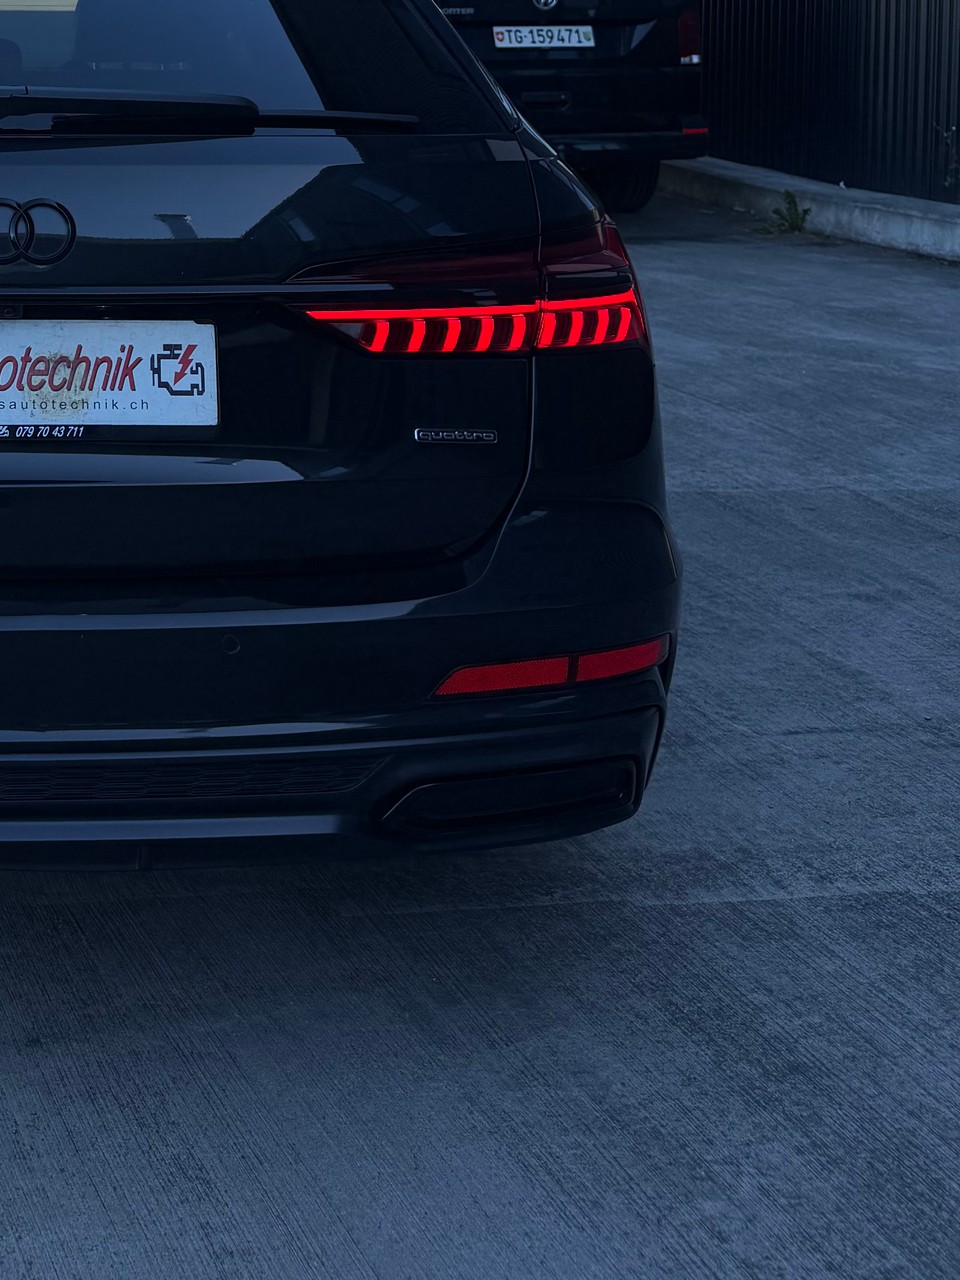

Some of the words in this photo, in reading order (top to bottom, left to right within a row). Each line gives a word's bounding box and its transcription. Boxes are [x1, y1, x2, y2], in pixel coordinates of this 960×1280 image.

[442, 7, 474, 15] ORTER
[15, 426, 35, 439] 079
[36, 426, 50, 439] 70
[52, 426, 66, 438] 43
[66, 426, 84, 438] 711
[419, 431, 495, 441] quattro
